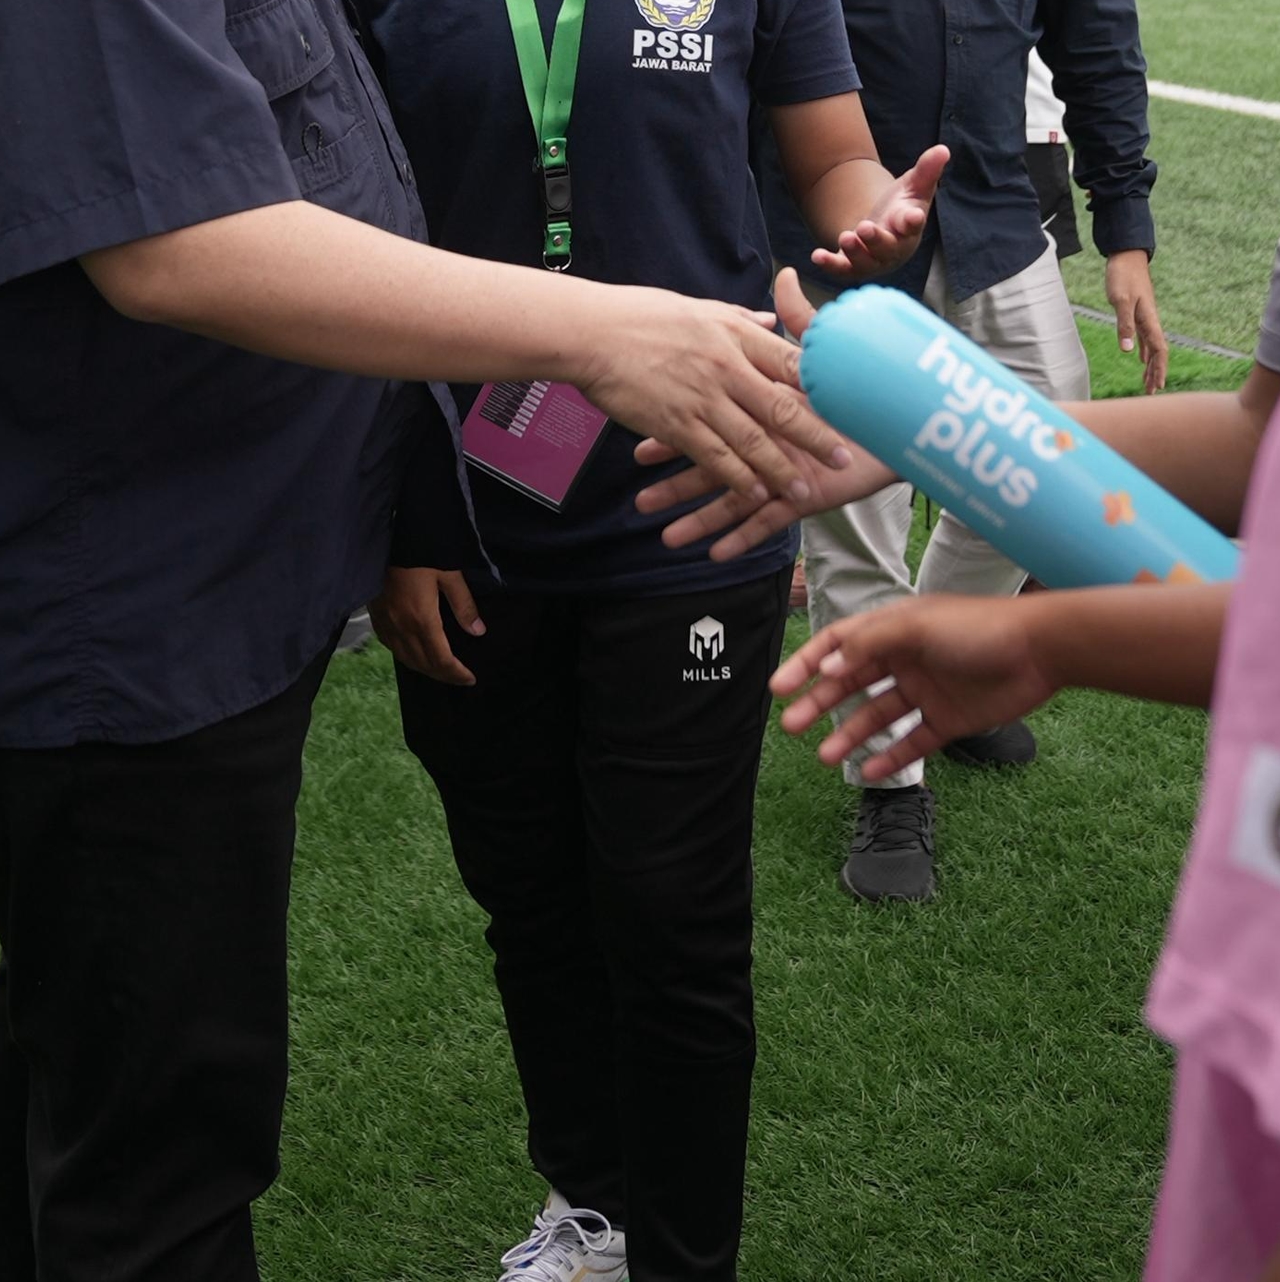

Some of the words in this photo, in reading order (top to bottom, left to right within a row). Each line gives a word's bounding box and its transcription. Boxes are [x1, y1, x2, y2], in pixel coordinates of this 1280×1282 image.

[632, 28, 714, 62] PSSI
[631, 57, 669, 72] JAWA
[671, 59, 712, 73] BARAT
[917, 334, 1070, 463] hydro
[913, 409, 1039, 507] plus
[682, 665, 731, 682] MILLS
